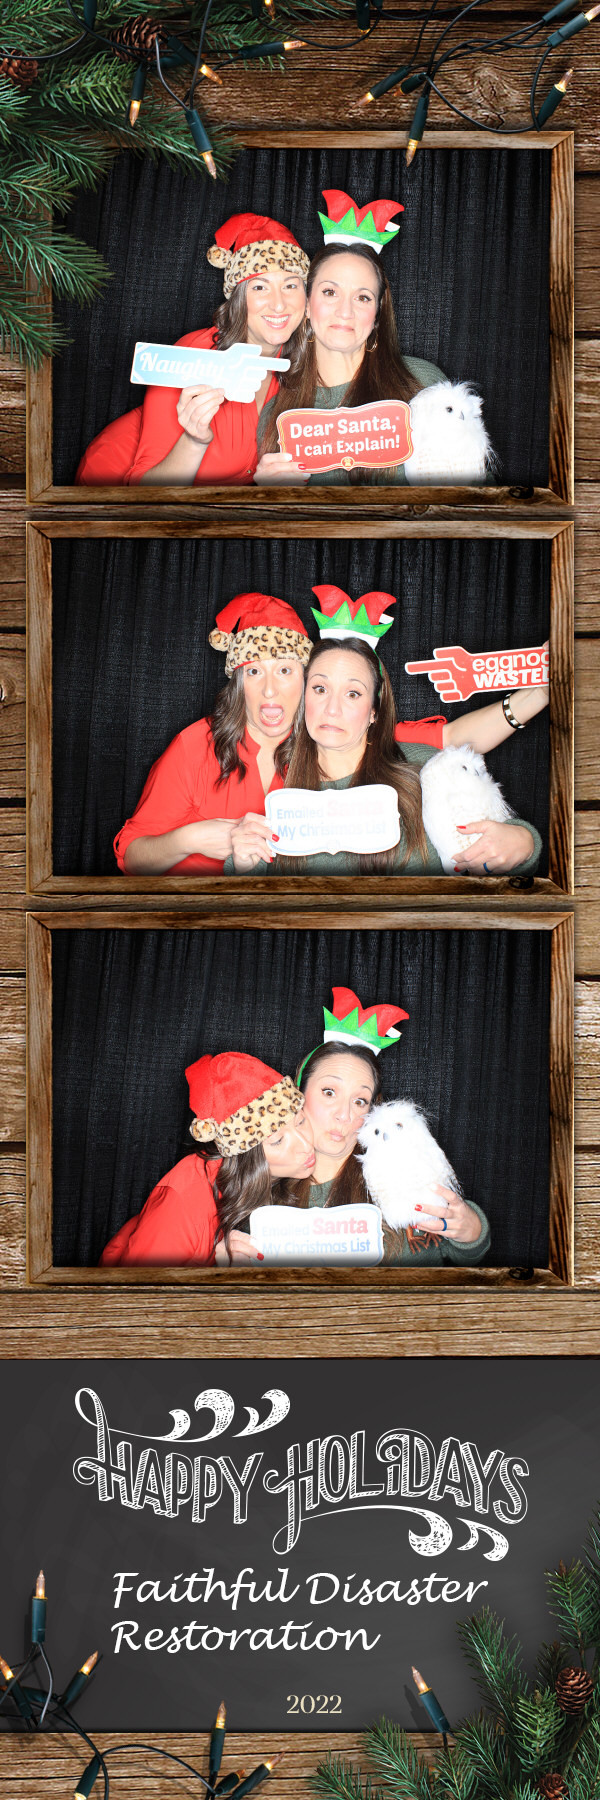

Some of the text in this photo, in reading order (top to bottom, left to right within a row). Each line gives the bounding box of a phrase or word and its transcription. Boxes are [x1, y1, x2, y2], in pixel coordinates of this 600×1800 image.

[140, 352, 225, 383] Naughty
[290, 416, 396, 439] Dear Santa,
[296, 434, 400, 456] I can Explain!
[276, 799, 384, 820] Emailed Santa
[278, 820, 387, 840] My Christmas List
[262, 1217, 368, 1236] Emailed Santa
[263, 1238, 370, 1256] My Christmas List
